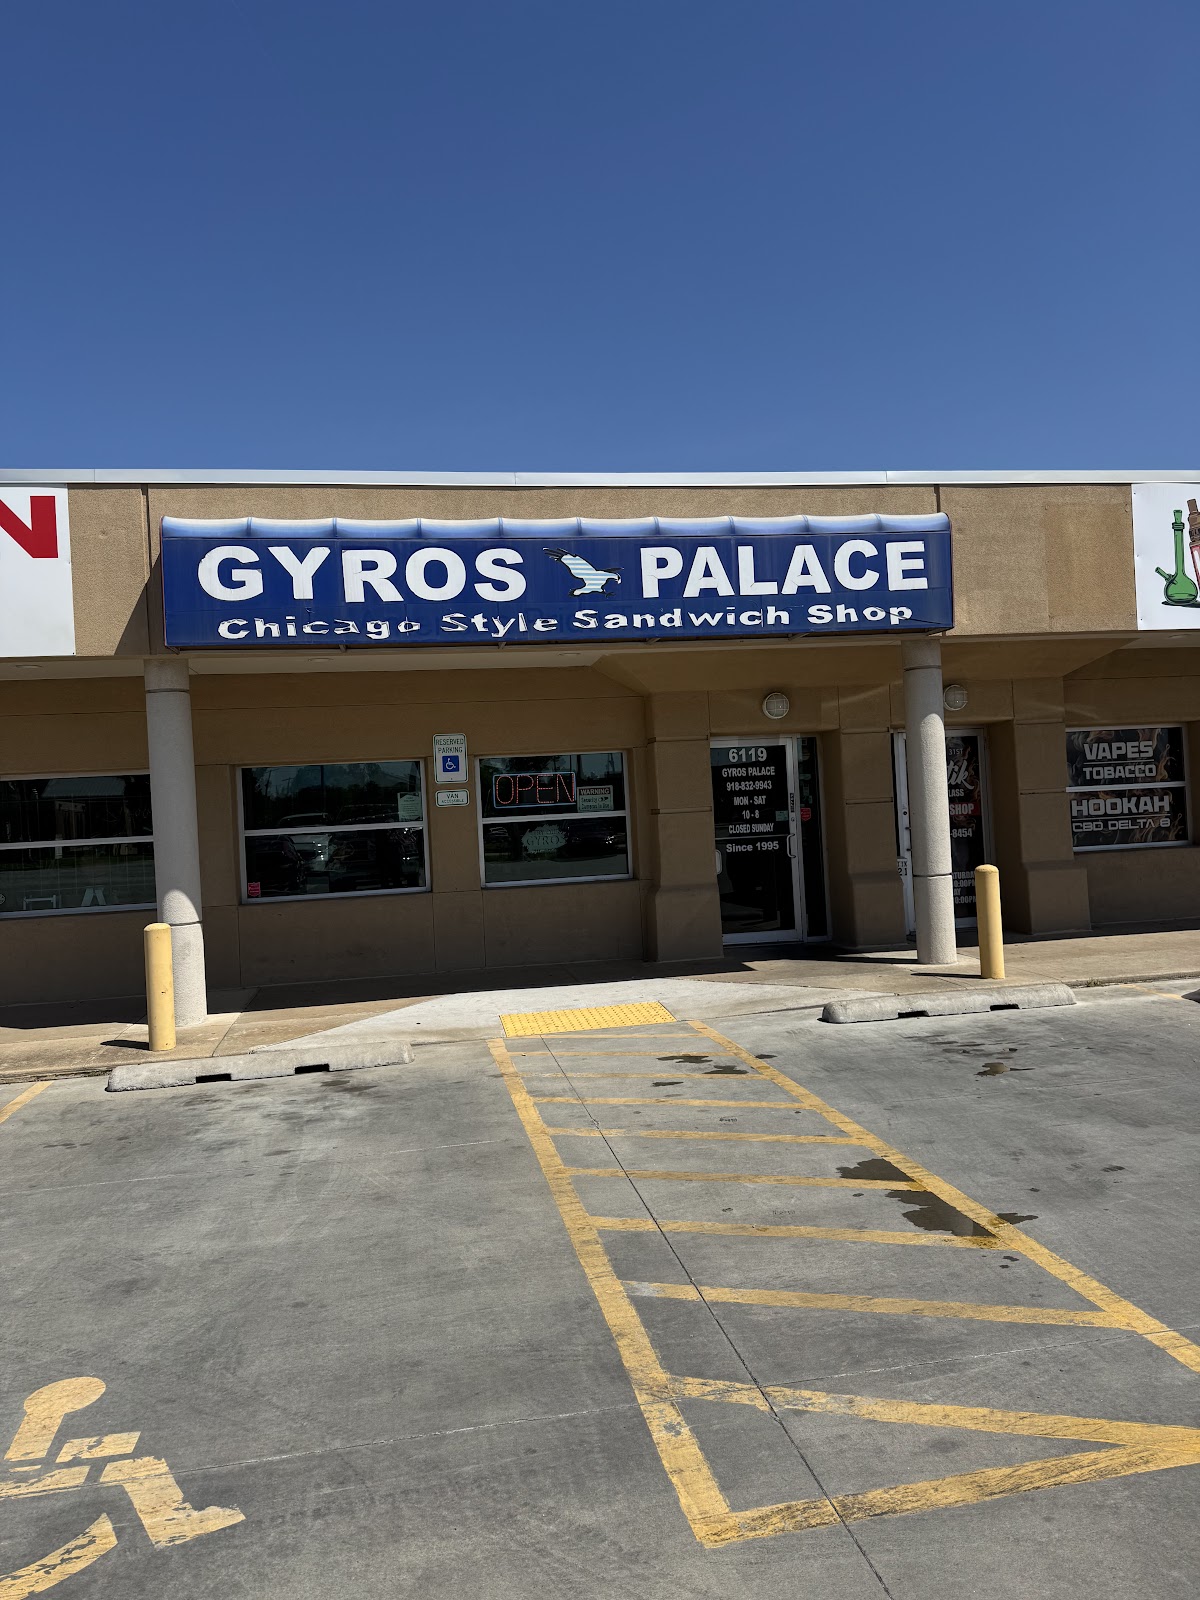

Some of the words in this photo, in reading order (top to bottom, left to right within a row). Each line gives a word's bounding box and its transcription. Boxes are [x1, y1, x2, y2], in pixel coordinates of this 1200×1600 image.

[198, 545, 526, 602] GYROS
[640, 539, 928, 598] PALACE
[217, 615, 421, 640] Chicago
[440, 612, 558, 638] Style
[573, 605, 790, 629] Sandwich
[808, 603, 913, 626] Shop
[435, 738, 464, 746] RESERVED
[437, 746, 463, 754] PARKING
[728, 747, 767, 762] 6119
[1083, 741, 1154, 760] VAPES
[722, 767, 747, 777] GYROS
[748, 766, 776, 776] PALACE
[1083, 764, 1157, 780] TOBACCO
[496, 773, 575, 805] OPEN
[726, 780, 772, 791] 918-832-9943
[581, 788, 610, 796] WARNING
[733, 797, 749, 805] MON
[754, 796, 767, 805] SAT
[1071, 795, 1170, 817] HOOKAH
[742, 810, 749, 819] 10
[755, 810, 760, 819] 8
[949, 803, 975, 815] SHOP
[728, 824, 751, 834] CLOSED
[751, 822, 775, 833] SUNDAY
[1072, 822, 1104, 832] CBD
[1108, 819, 1156, 831] DELTA
[1160, 818, 1171, 828] 8
[726, 843, 753, 853] Since
[755, 841, 779, 851] 1995
